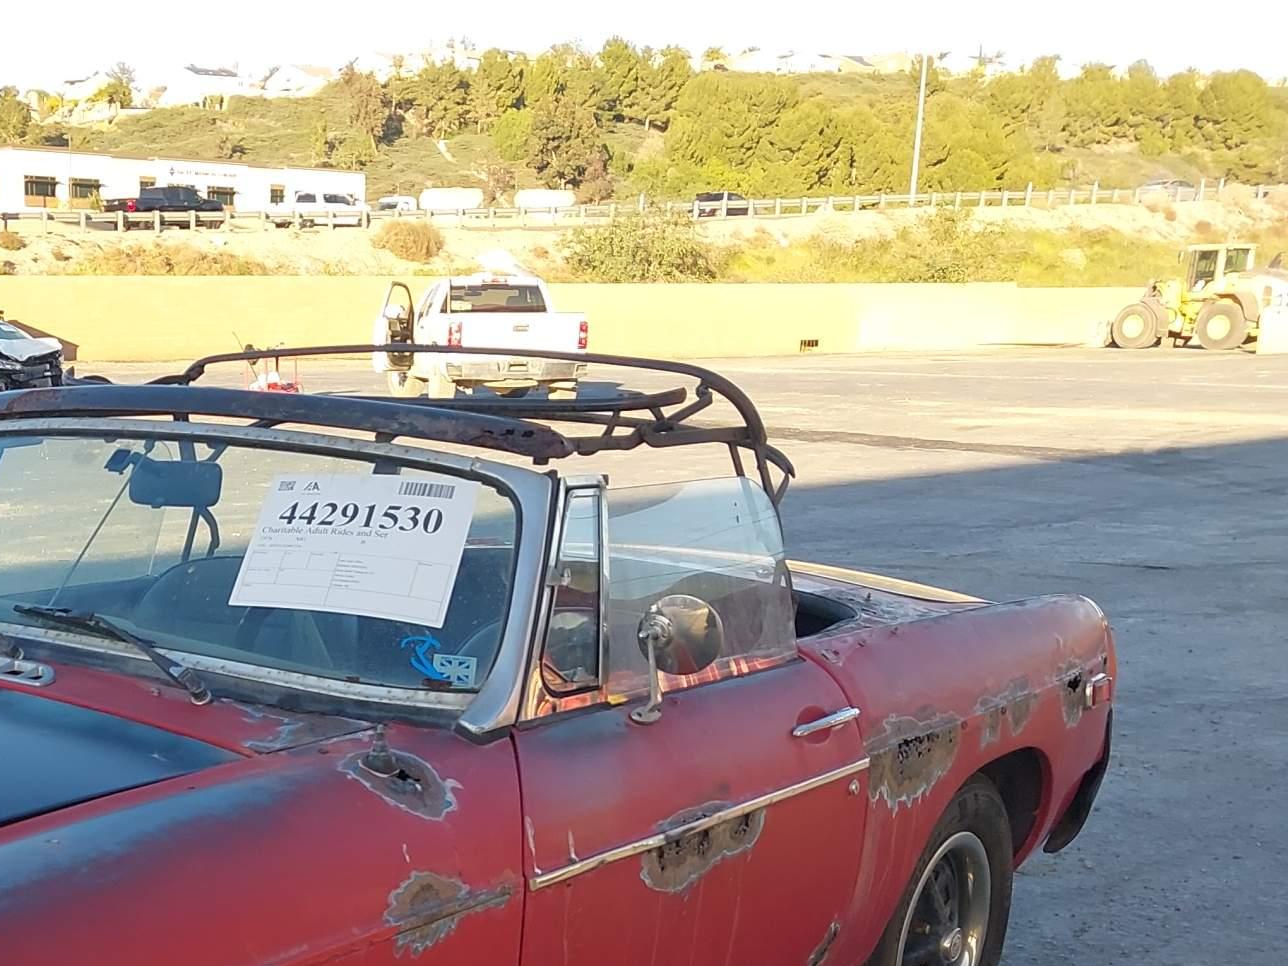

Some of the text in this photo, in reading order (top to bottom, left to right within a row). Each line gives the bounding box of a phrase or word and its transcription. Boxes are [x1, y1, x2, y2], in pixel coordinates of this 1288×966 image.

[279, 501, 444, 535] 44291530
[262, 526, 390, 539] Charitable Adult Rides and Ser
